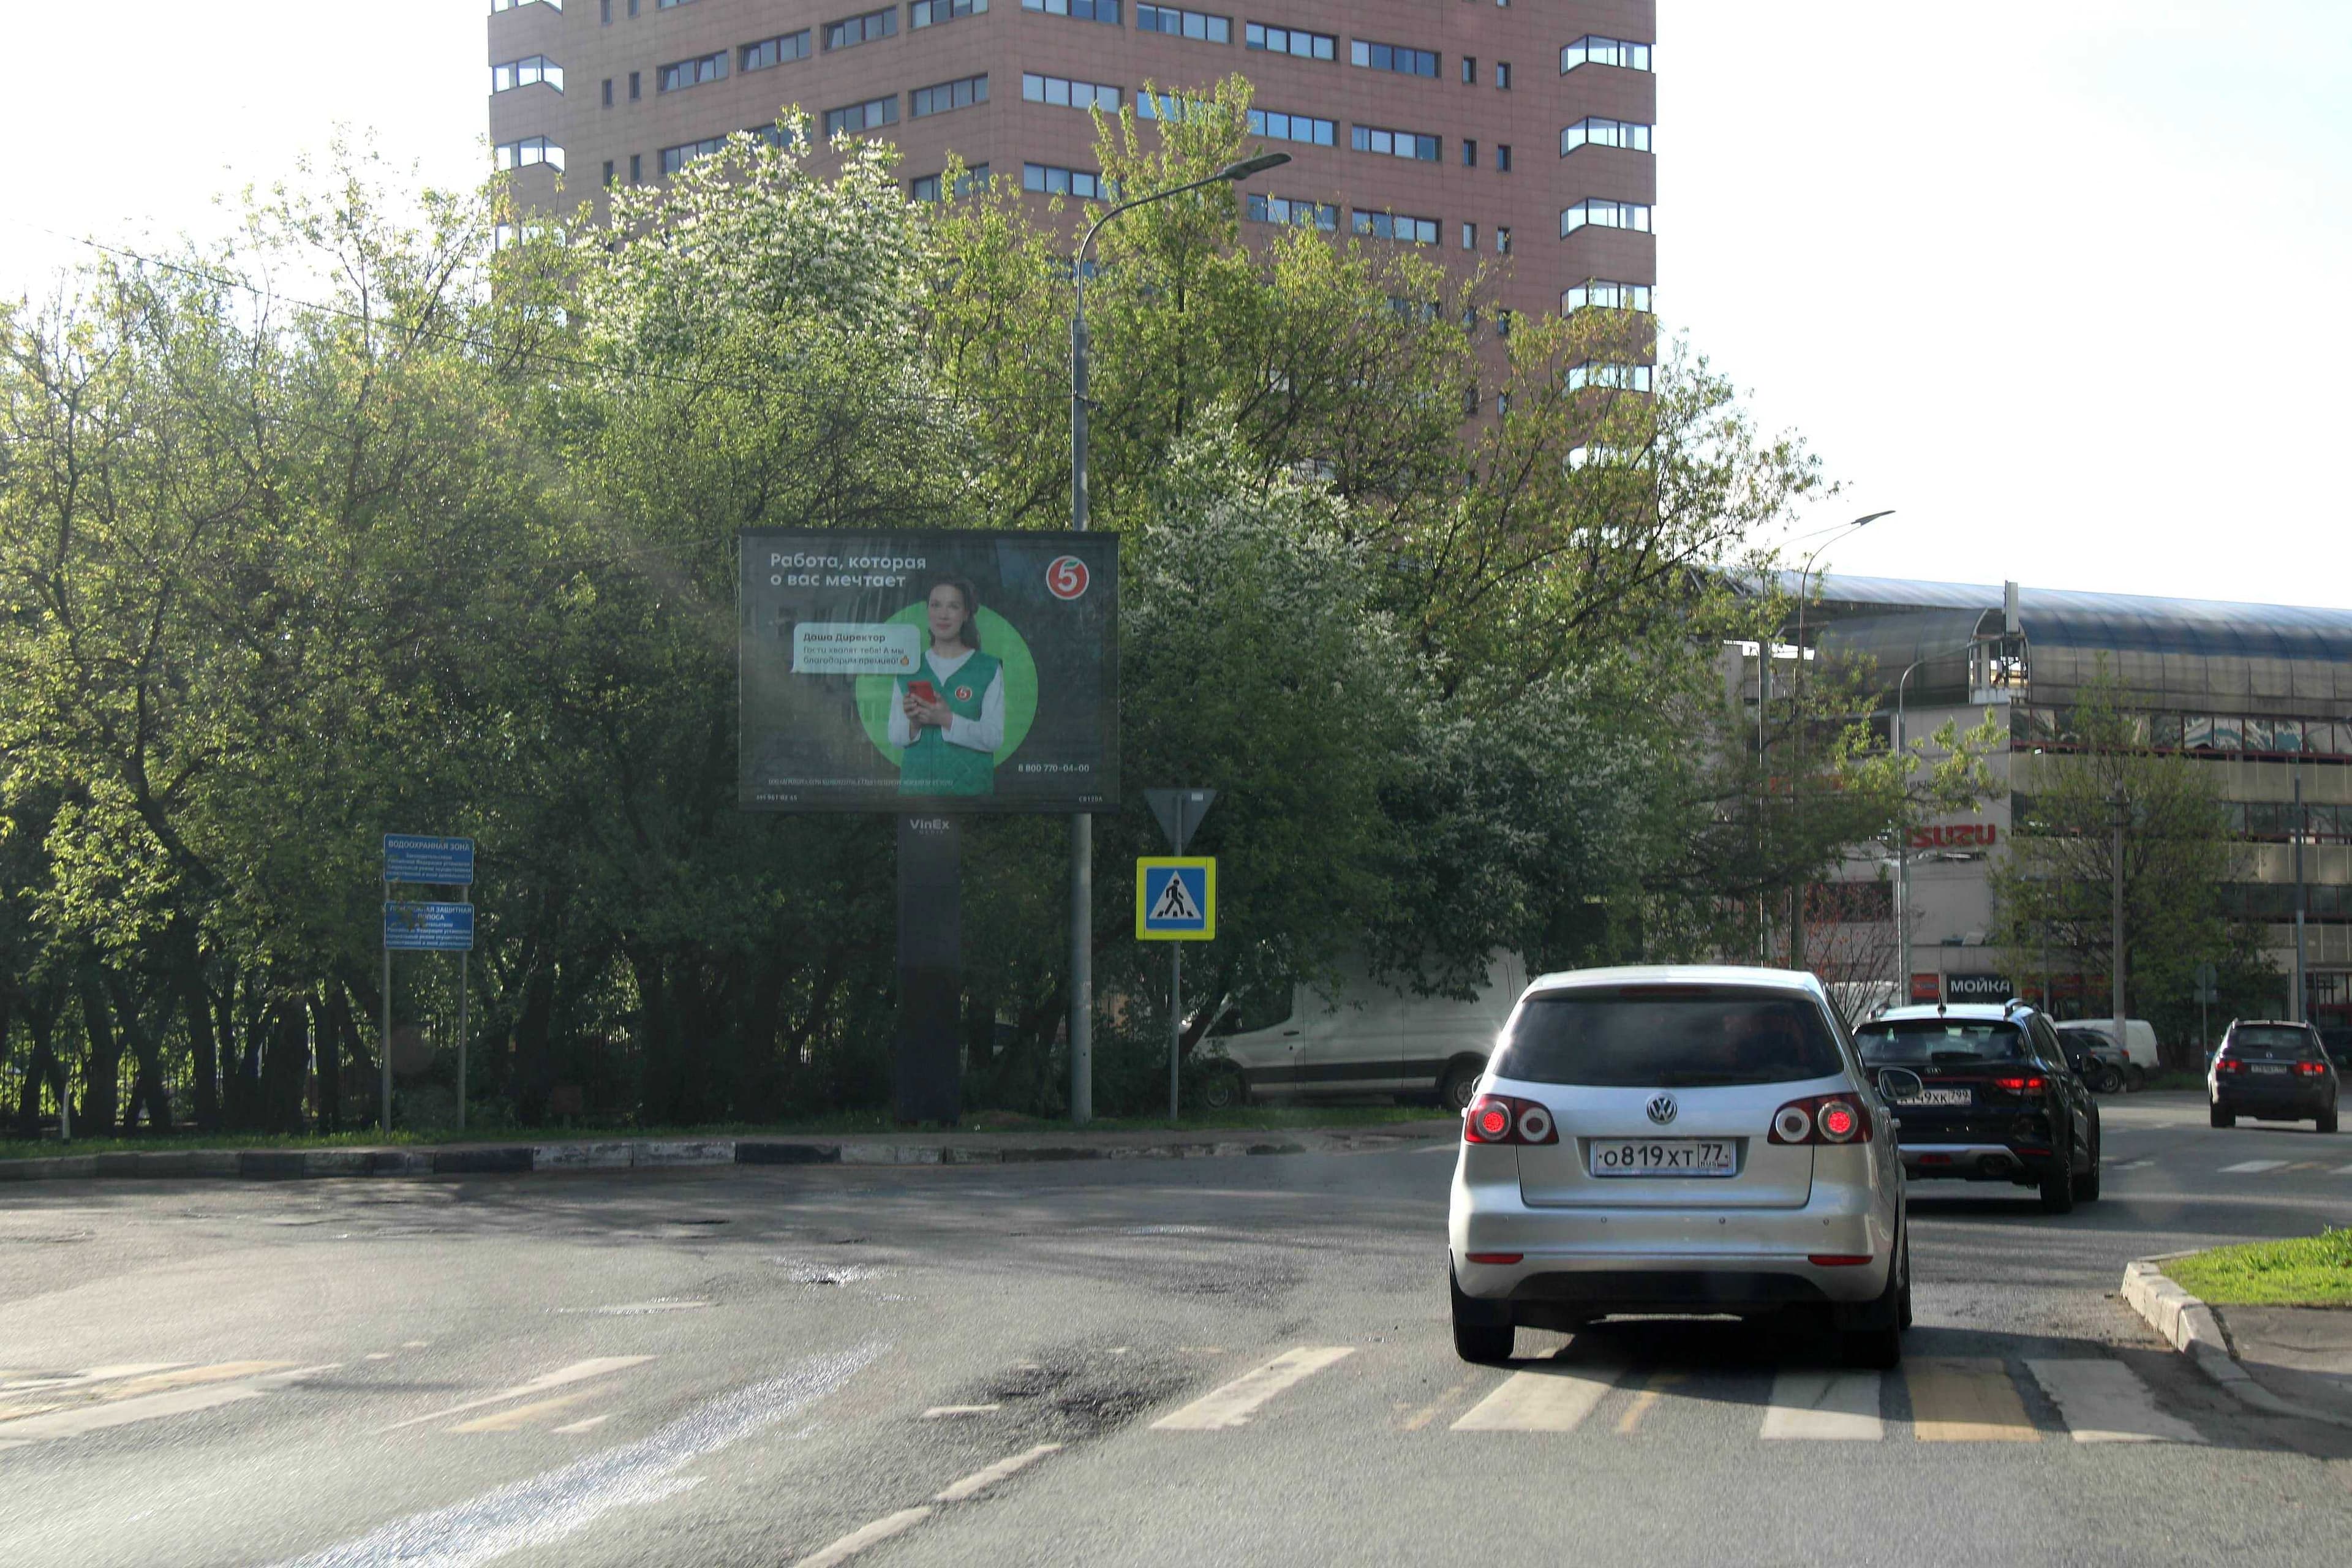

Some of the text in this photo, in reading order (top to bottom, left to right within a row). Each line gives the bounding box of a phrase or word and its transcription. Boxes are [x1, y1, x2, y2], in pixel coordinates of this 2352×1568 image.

[771, 552, 926, 573] Работа, которая
[770, 575, 907, 588] о вас мечтает
[803, 633, 886, 644] Даша Директор
[1906, 823, 1996, 847] ISUZU
[388, 840, 470, 851] ВОДООХРАННАЯ ЗОНА
[1951, 977, 2010, 993] МОЙКА
[1700, 1144, 1723, 1160] 77
